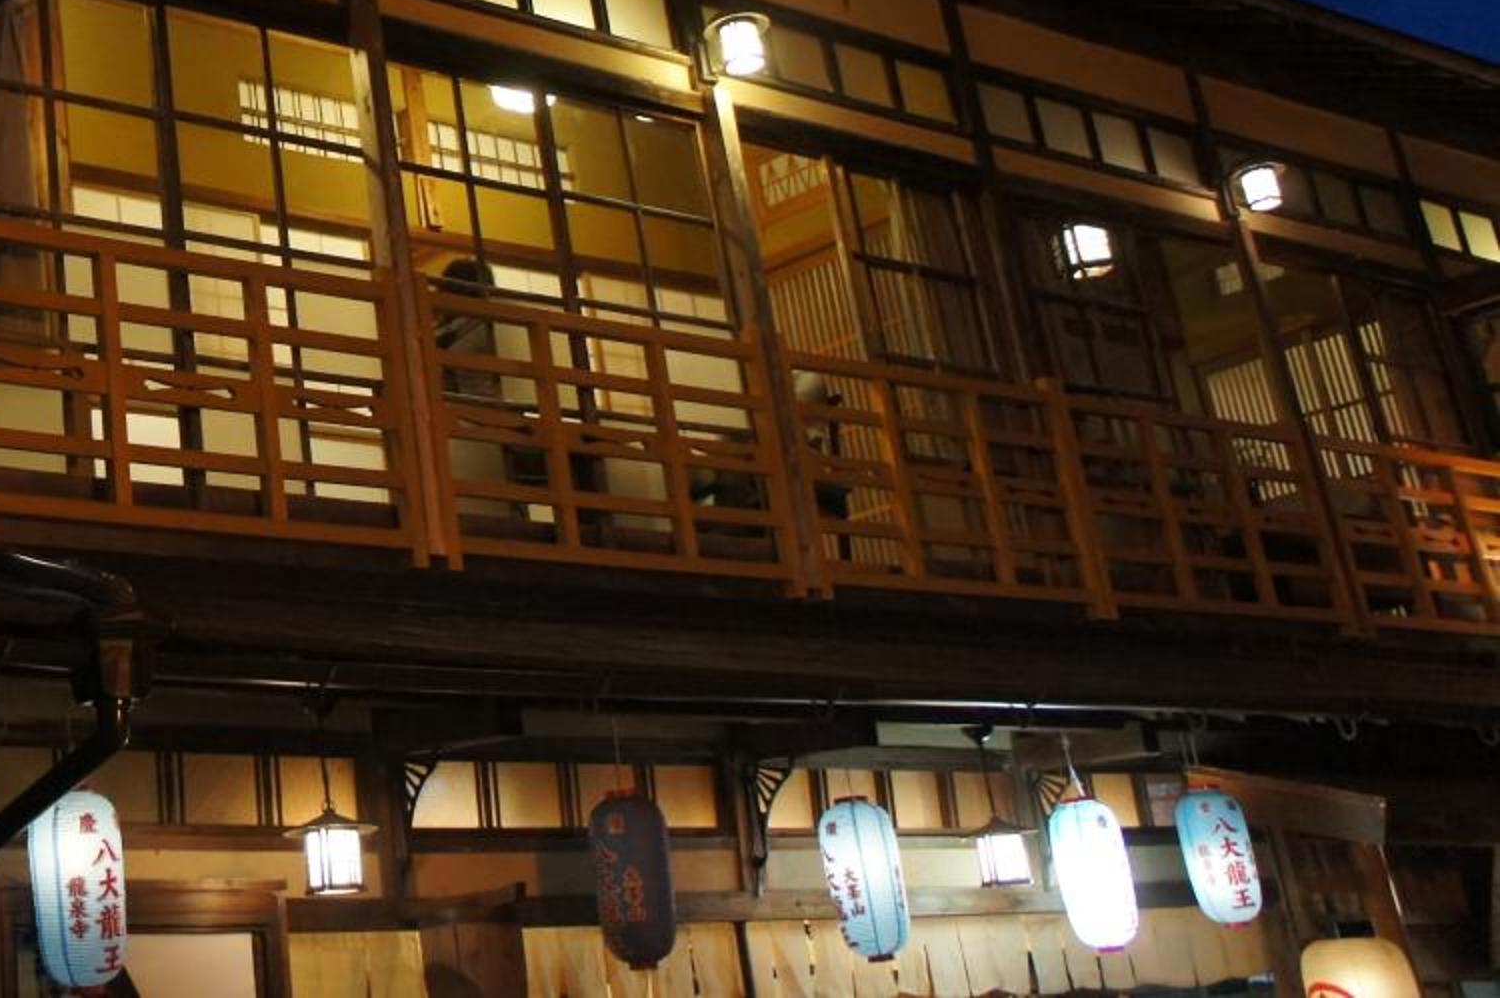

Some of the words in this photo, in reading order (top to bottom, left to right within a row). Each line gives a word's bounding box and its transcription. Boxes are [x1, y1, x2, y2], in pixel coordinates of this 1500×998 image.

[91, 837, 122, 974] 八大龍王
[1212, 817, 1256, 909] 八大龍王
